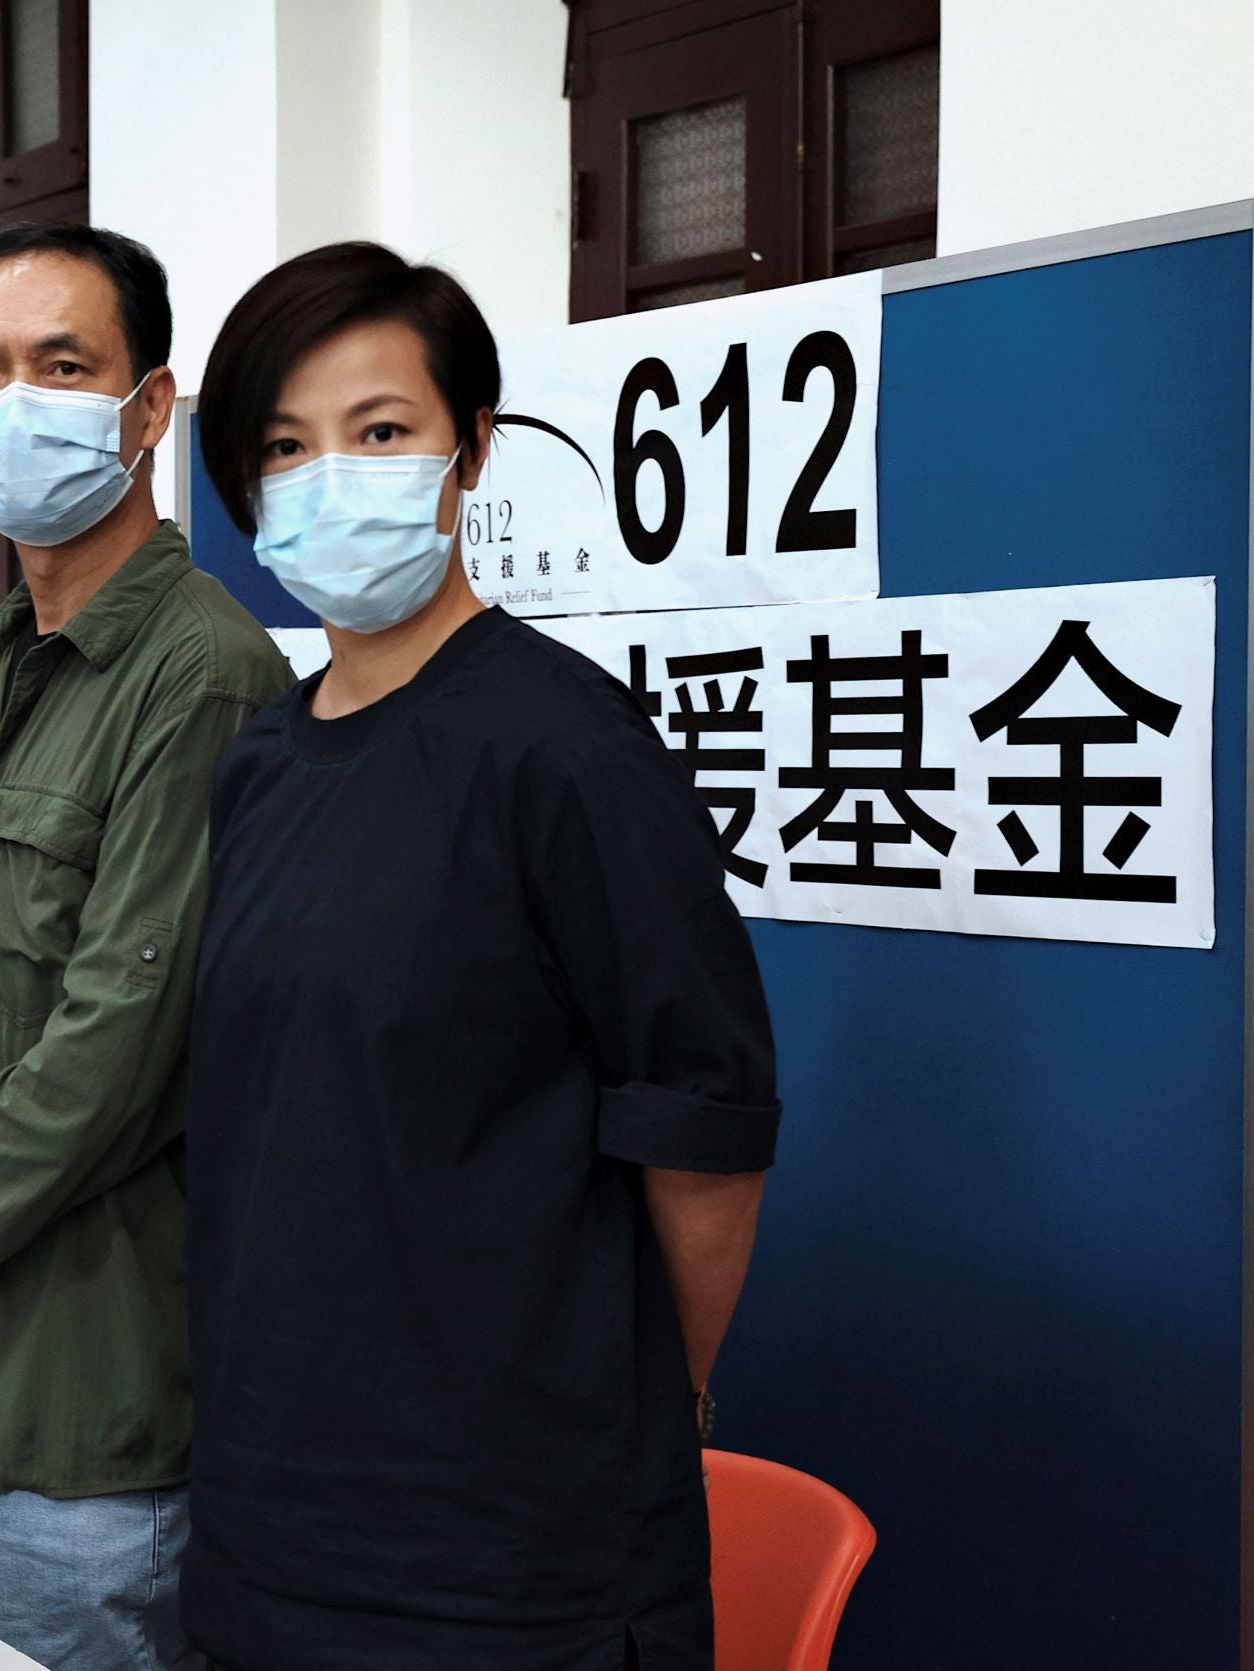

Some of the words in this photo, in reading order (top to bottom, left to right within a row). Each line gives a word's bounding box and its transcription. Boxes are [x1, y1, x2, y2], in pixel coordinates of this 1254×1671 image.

[613, 329, 858, 565] 612
[466, 500, 513, 546] 612
[469, 547, 590, 582] 支援基金
[505, 590, 529, 604] Relief
[531, 588, 553, 602] Fund
[629, 619, 1181, 904] 援基金
